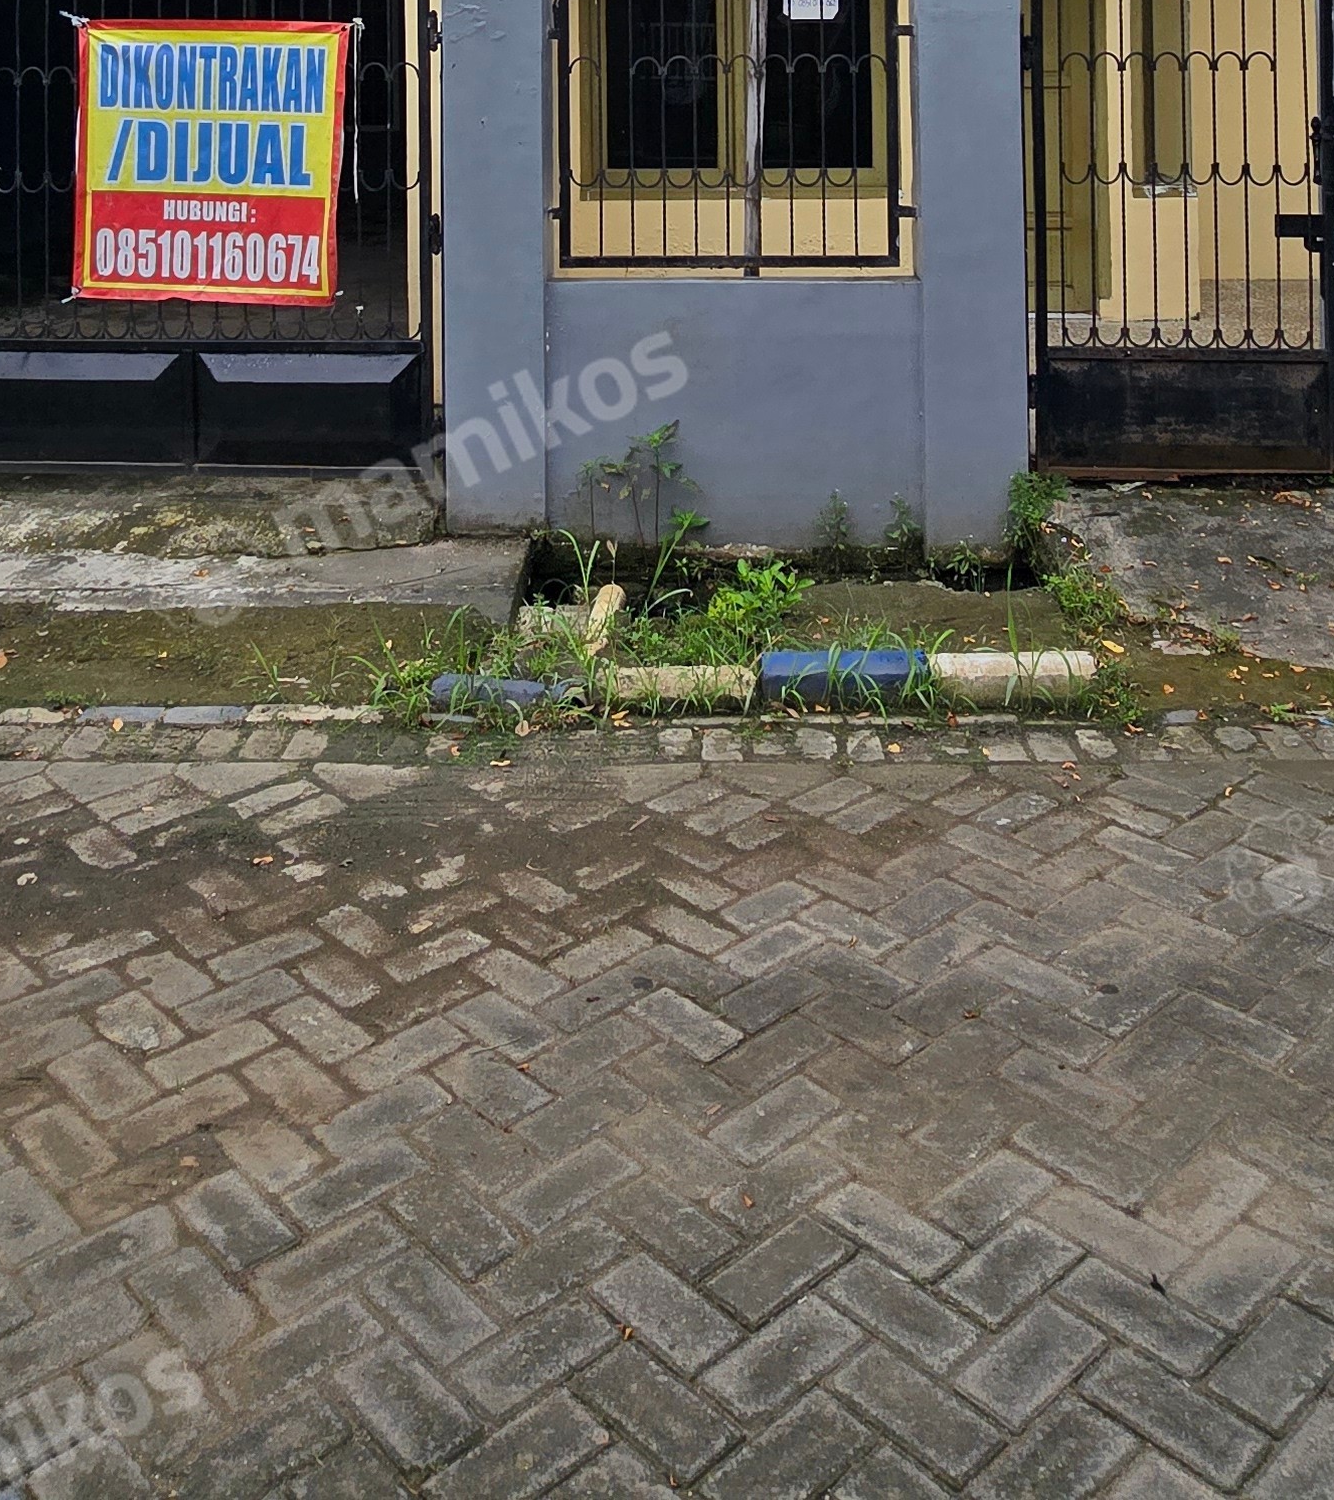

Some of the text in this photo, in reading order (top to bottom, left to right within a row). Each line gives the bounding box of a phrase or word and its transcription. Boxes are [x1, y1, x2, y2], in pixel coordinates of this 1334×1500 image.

[98, 41, 326, 115] DIKONTRAKAN
[106, 117, 313, 187] /DIJUAL
[95, 227, 320, 285] 085101160674
